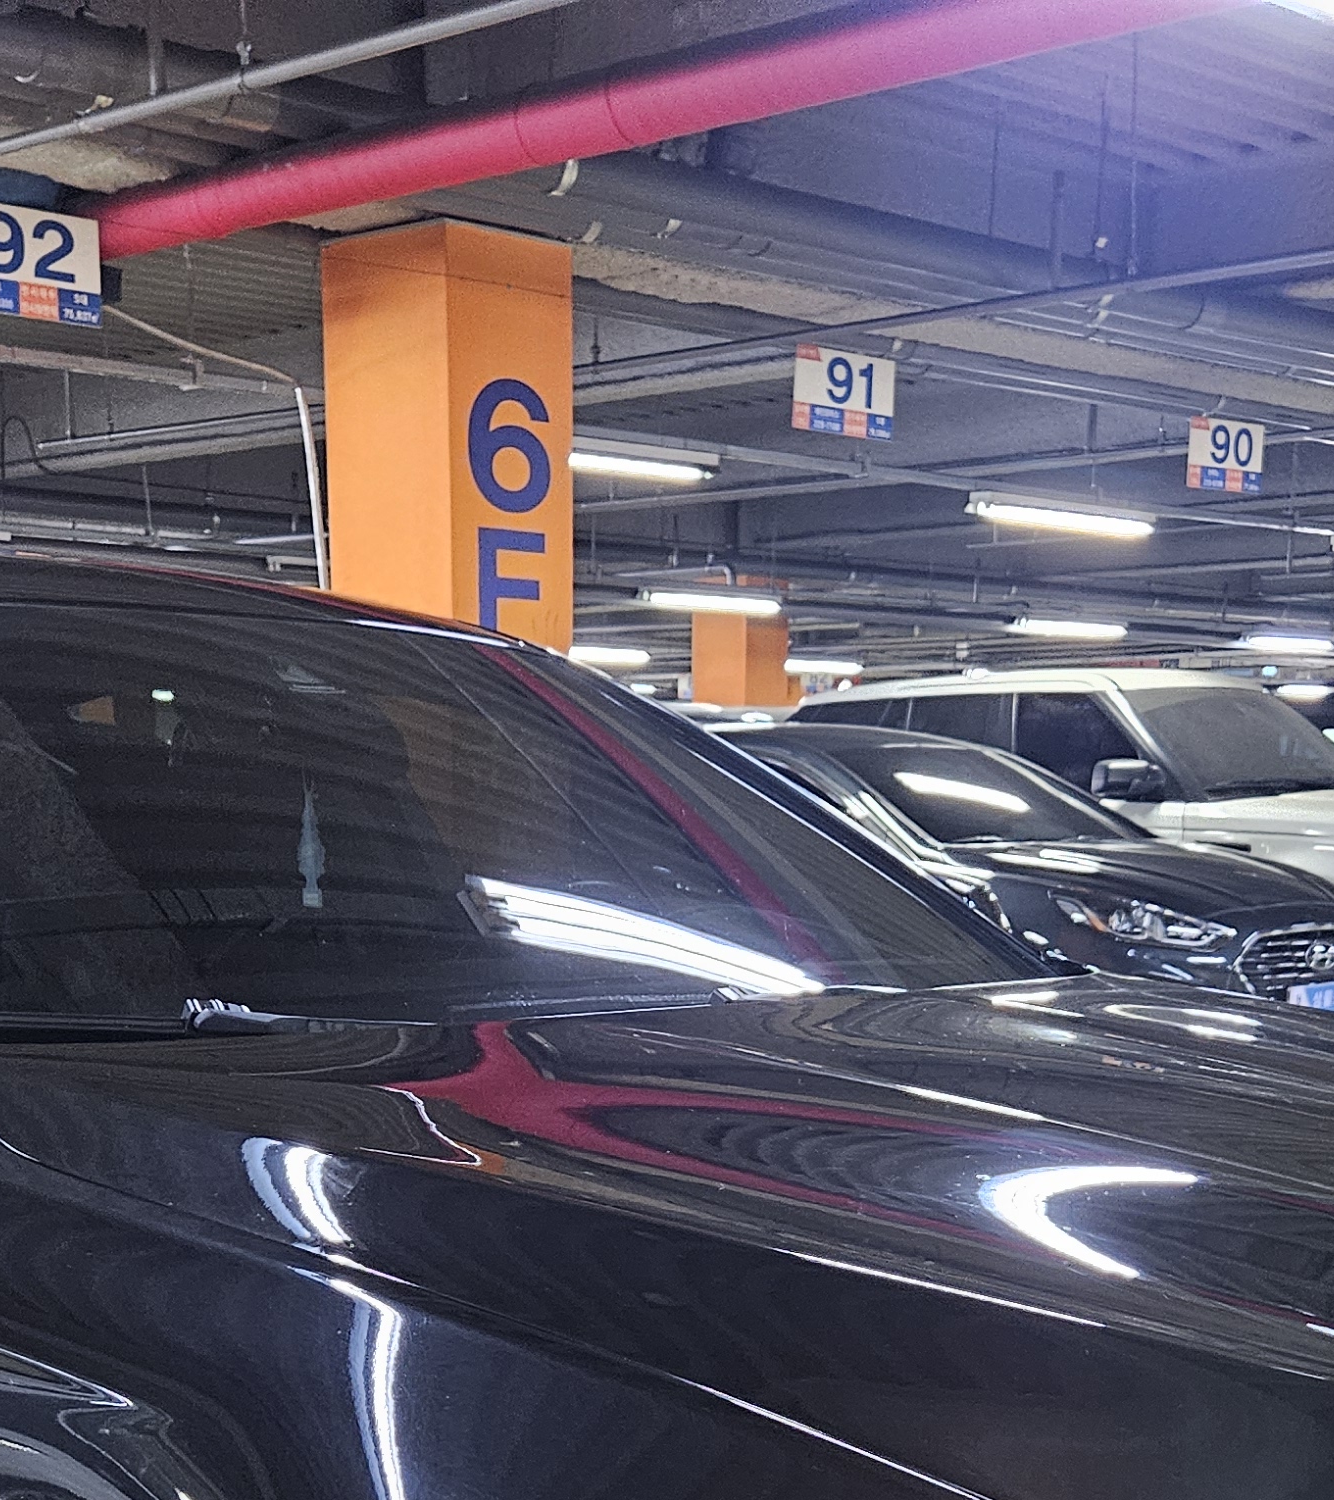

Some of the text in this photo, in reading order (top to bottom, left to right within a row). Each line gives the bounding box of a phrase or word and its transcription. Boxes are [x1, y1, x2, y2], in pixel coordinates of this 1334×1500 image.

[826, 357, 873, 409] 91
[1210, 425, 1253, 467] 90
[468, 378, 552, 632] 6F
